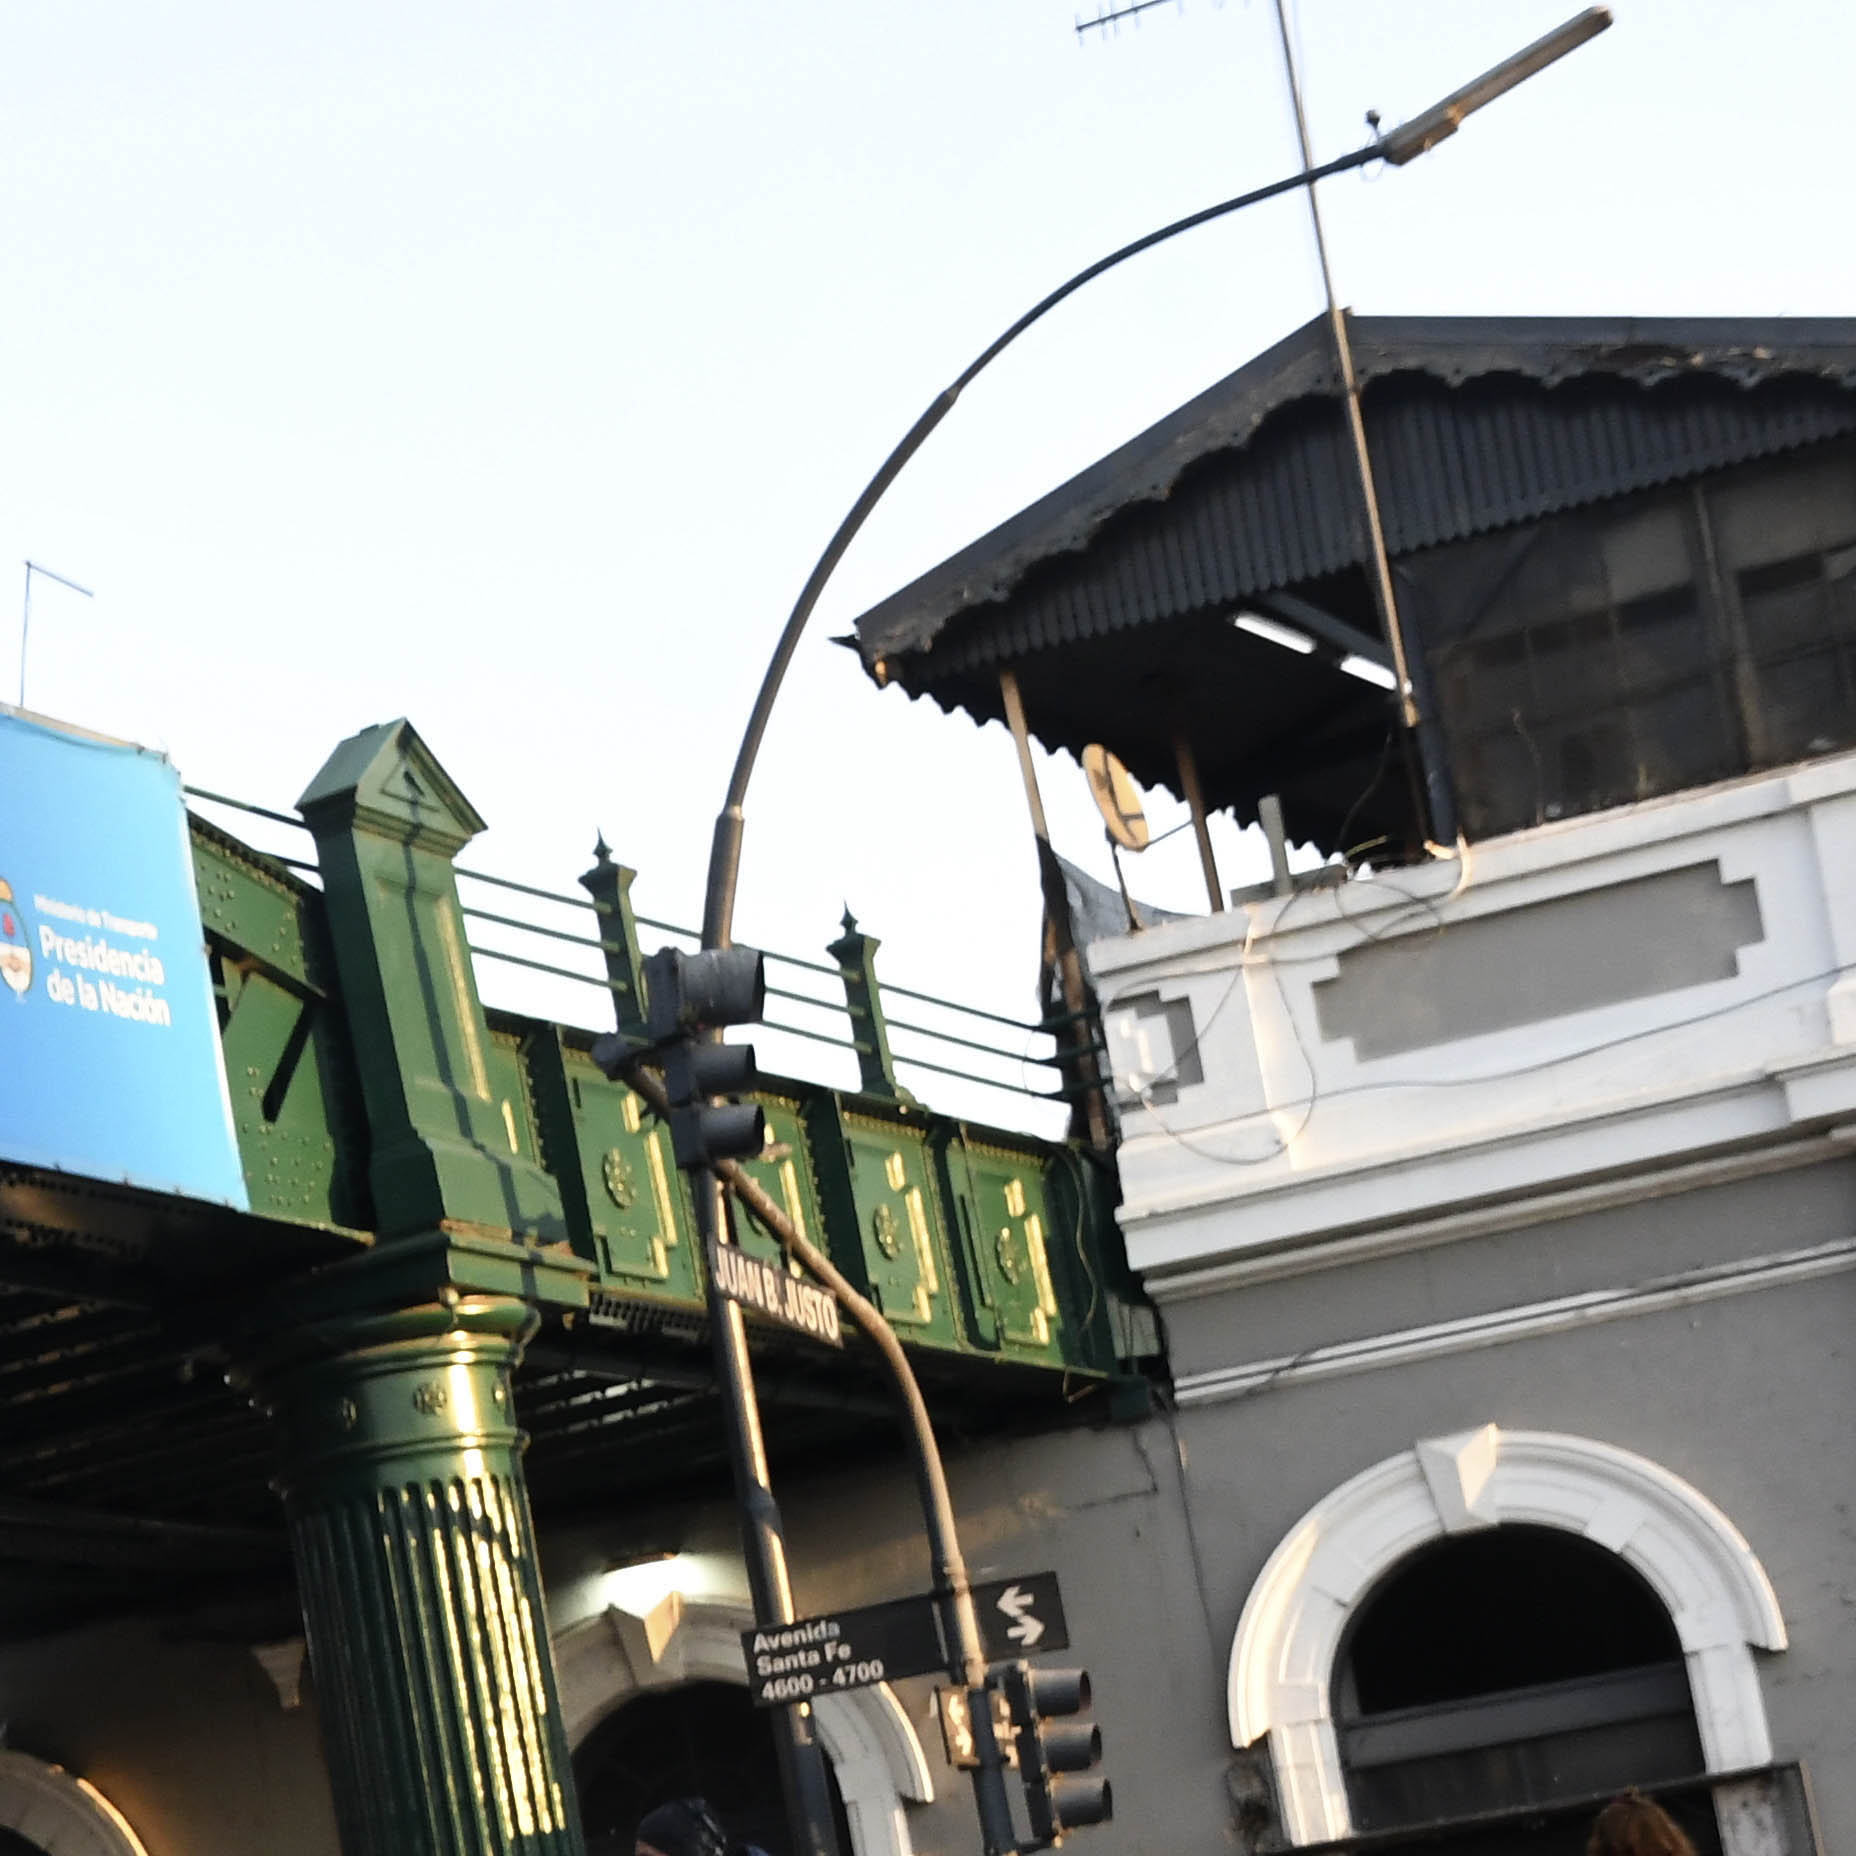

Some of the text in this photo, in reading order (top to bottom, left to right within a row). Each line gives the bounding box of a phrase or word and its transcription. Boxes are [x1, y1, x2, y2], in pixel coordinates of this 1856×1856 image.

[39, 924, 165, 985] Presidencia
[46, 968, 172, 1027] de la Nación
[715, 1245, 764, 1308] JUAN
[785, 1277, 840, 1340] JUSTO
[753, 1619, 840, 1654] Avenida
[756, 1641, 852, 1676] Santa Fe
[761, 1673, 814, 1701] 4600
[832, 1659, 885, 1687] 4700
